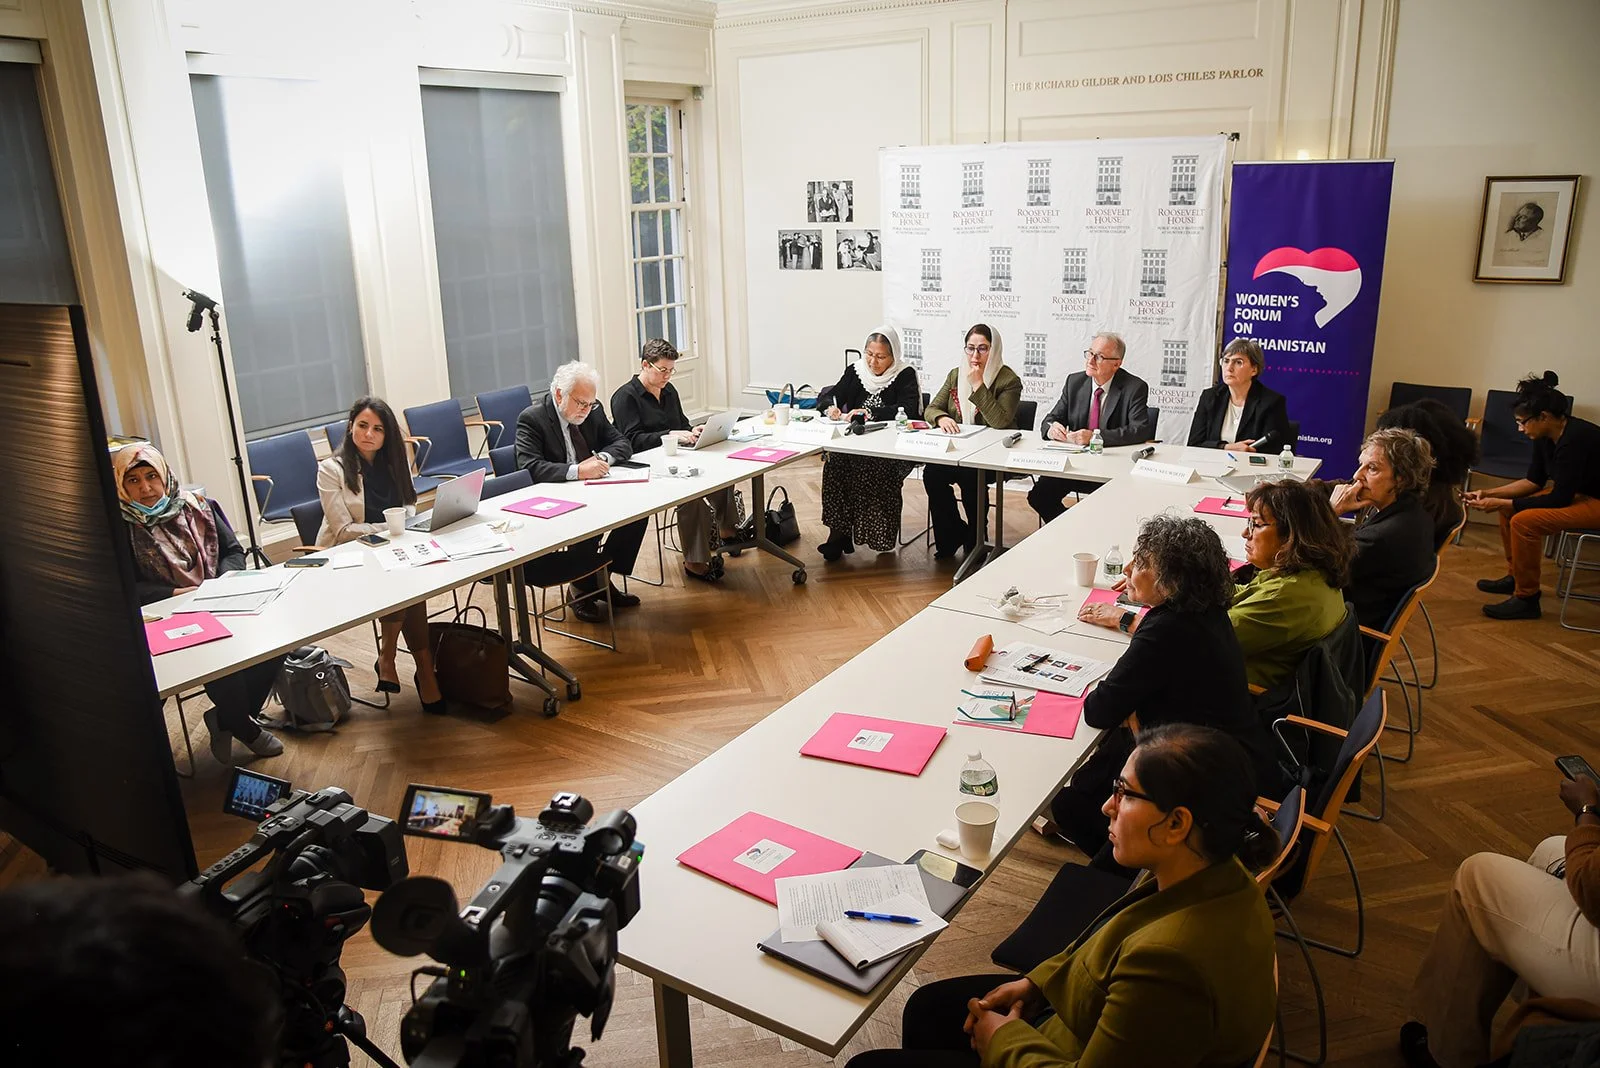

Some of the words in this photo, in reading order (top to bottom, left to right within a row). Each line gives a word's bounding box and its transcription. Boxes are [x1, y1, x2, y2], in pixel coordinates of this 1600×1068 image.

[1013, 82, 1032, 91] THE
[1034, 79, 1080, 90] RICHARD
[1081, 76, 1120, 87] GILDER
[1122, 75, 1146, 85] AND
[1148, 73, 1173, 84] LOIS
[1175, 71, 1216, 82] CHILES
[1219, 68, 1264, 80] PARLOR
[892, 210, 930, 219] ROOSEVELT
[953, 209, 994, 218] ROOSEVELT
[1017, 208, 1060, 217] ROOSEVELT
[1085, 208, 1132, 217] ROOSEVELT
[1158, 208, 1206, 217] ROOSEVELT
[899, 218, 922, 226] HOUSE
[960, 217, 985, 226] HOUSE
[1025, 216, 1052, 224] HOUSE
[1094, 216, 1122, 224] HOUSE
[1167, 216, 1195, 224] HOUSE
[912, 293, 952, 302] ROOSEVELT
[980, 293, 1022, 303] ROOSEVELT
[1052, 296, 1096, 305] ROOSEVELT
[1236, 293, 1299, 307] WOMEN'S
[920, 300, 943, 308] HOUSE
[988, 301, 1013, 309] HOUSE
[1060, 303, 1086, 312] HOUSE
[1129, 298, 1176, 309] ROOSEVELT
[1137, 306, 1166, 315] HOUSE
[1234, 307, 1282, 322] FORUM
[1233, 321, 1253, 335] ON
[1234, 336, 1327, 354] HANISTAN
[1021, 380, 1056, 389] OOSEVELT
[1149, 387, 1197, 398] ROOSEVELT
[1157, 396, 1185, 405] HOUSE
